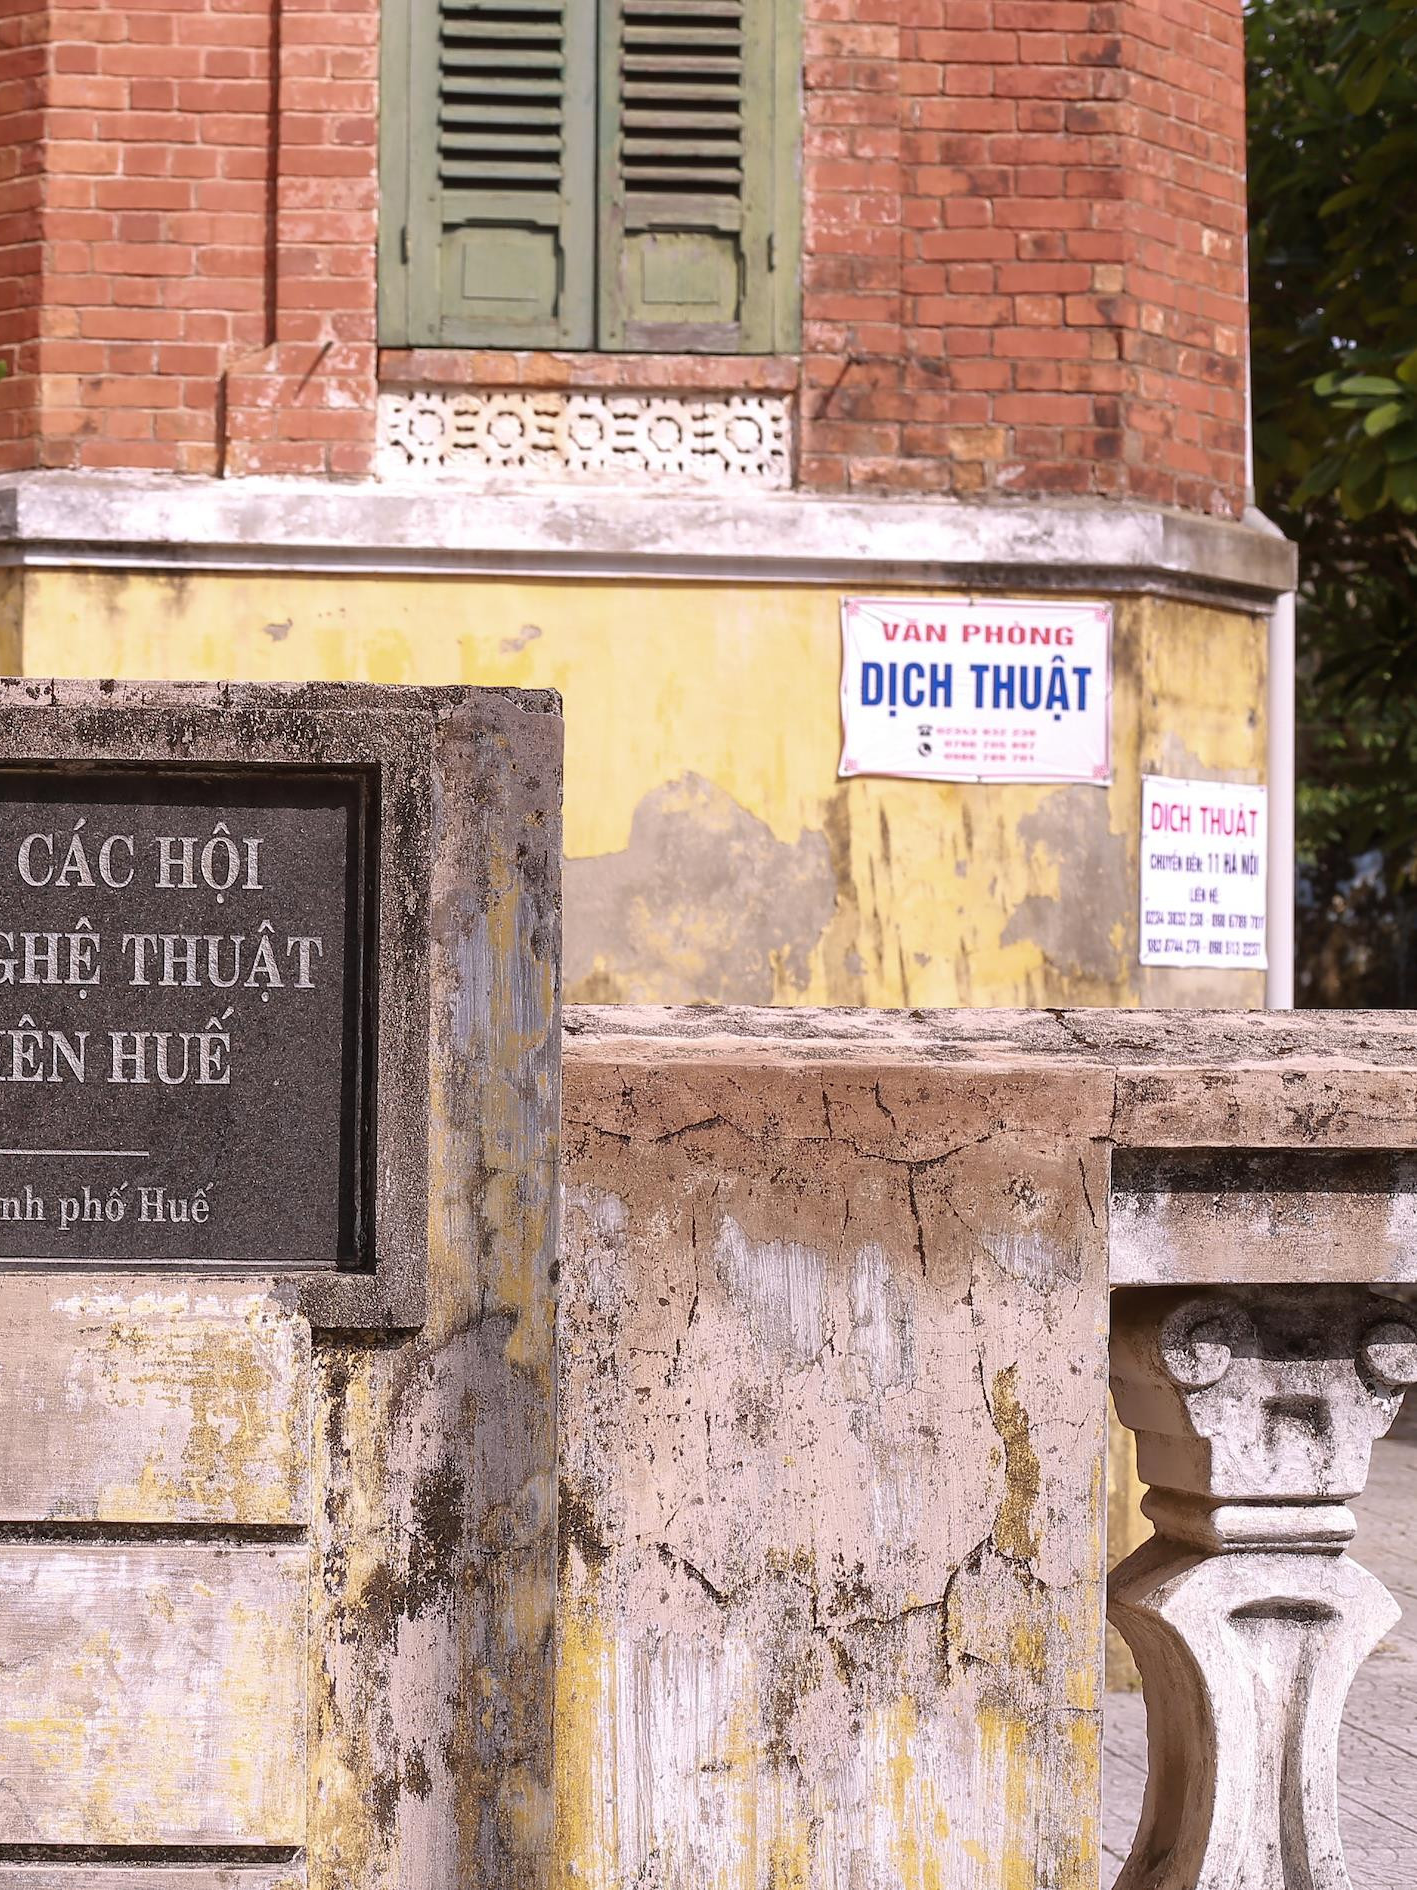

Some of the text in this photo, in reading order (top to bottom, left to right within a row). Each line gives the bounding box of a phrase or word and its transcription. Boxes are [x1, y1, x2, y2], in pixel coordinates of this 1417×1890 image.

[883, 620, 1075, 647] VĂN PHÒNG
[861, 654, 1092, 722] DỊCH THUẬT
[1199, 802, 1258, 843] THUẬT
[18, 817, 134, 888] CÁC
[155, 821, 264, 904] HỘI
[121, 919, 324, 1003] THUẬT
[107, 1006, 235, 1085] HUẾ
[58, 1180, 129, 1231] phố
[137, 1181, 214, 1223] Huế
